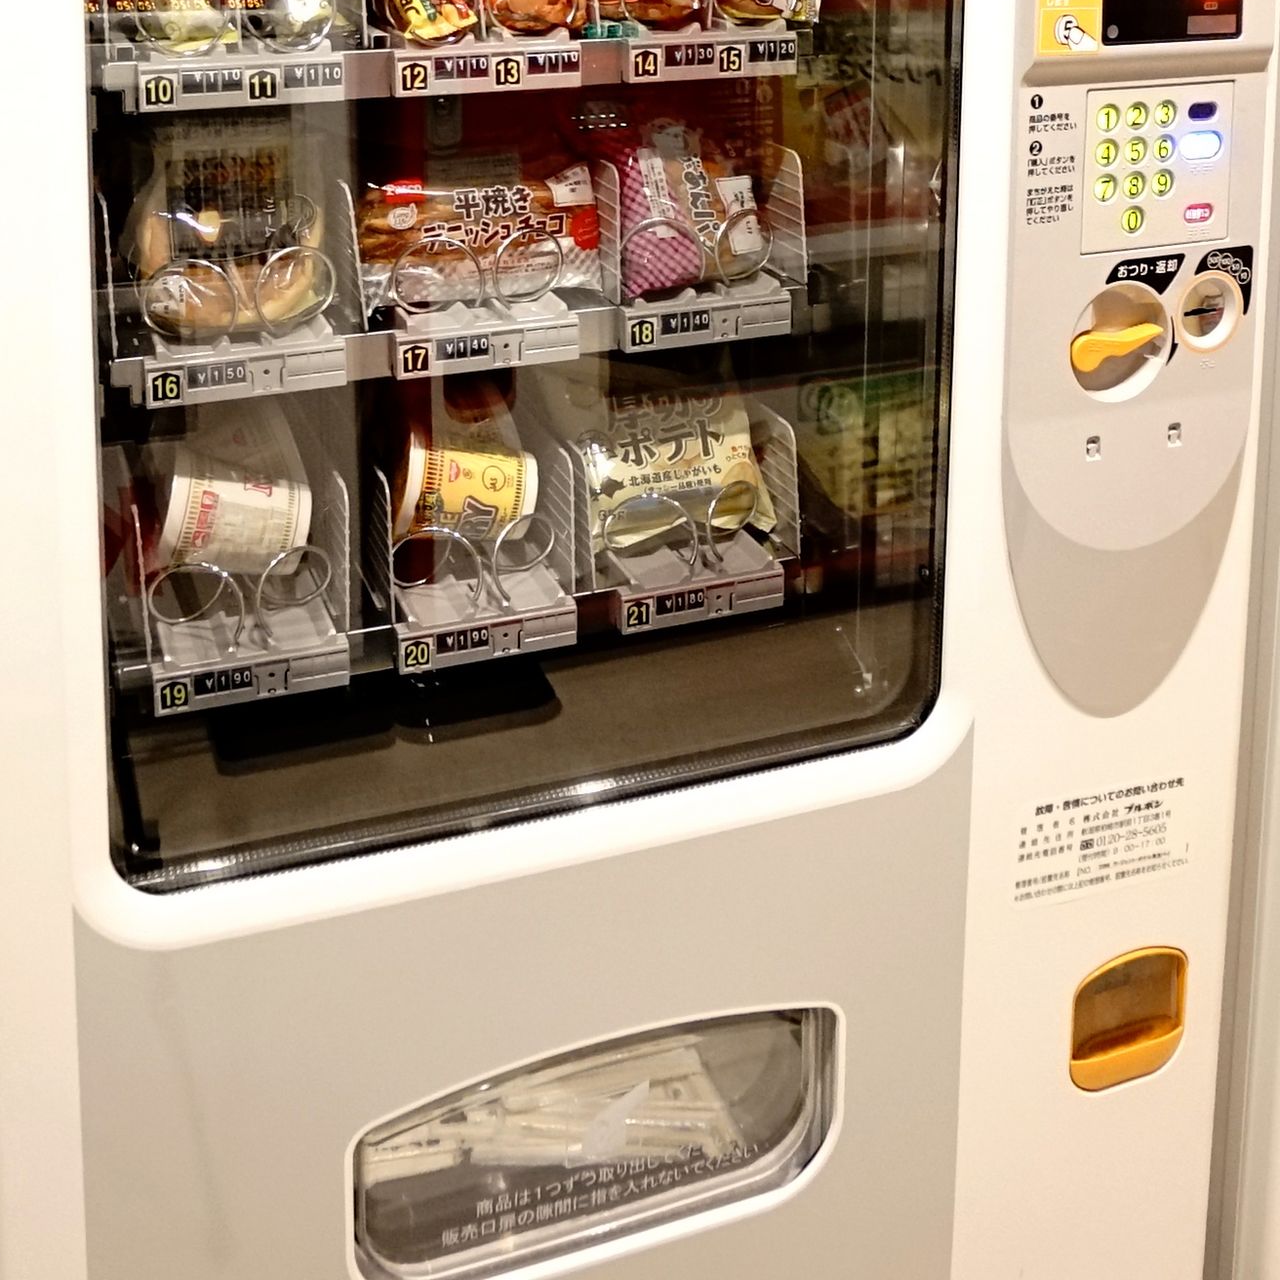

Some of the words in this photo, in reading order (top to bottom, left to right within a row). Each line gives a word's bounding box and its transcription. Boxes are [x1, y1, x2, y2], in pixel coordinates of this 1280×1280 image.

[635, 54, 656, 75] 14
[720, 50, 740, 70] 15
[402, 67, 426, 88] 12
[496, 63, 519, 84] 13
[147, 78, 172, 103] 10
[250, 75, 273, 97] 11
[453, 185, 533, 220] 平焼き
[421, 212, 567, 254] デニッシュチョコ
[1117, 259, 1178, 278] おつり・返却
[632, 323, 653, 344] 18
[403, 348, 427, 371] 17
[153, 376, 178, 399] 16
[619, 419, 725, 470] ポテト
[627, 462, 722, 488] 北海道産じゃがいも
[628, 605, 648, 625] 21
[406, 643, 428, 665] 20
[162, 684, 187, 705] 19
[1123, 799, 1164, 816] ブルボン
